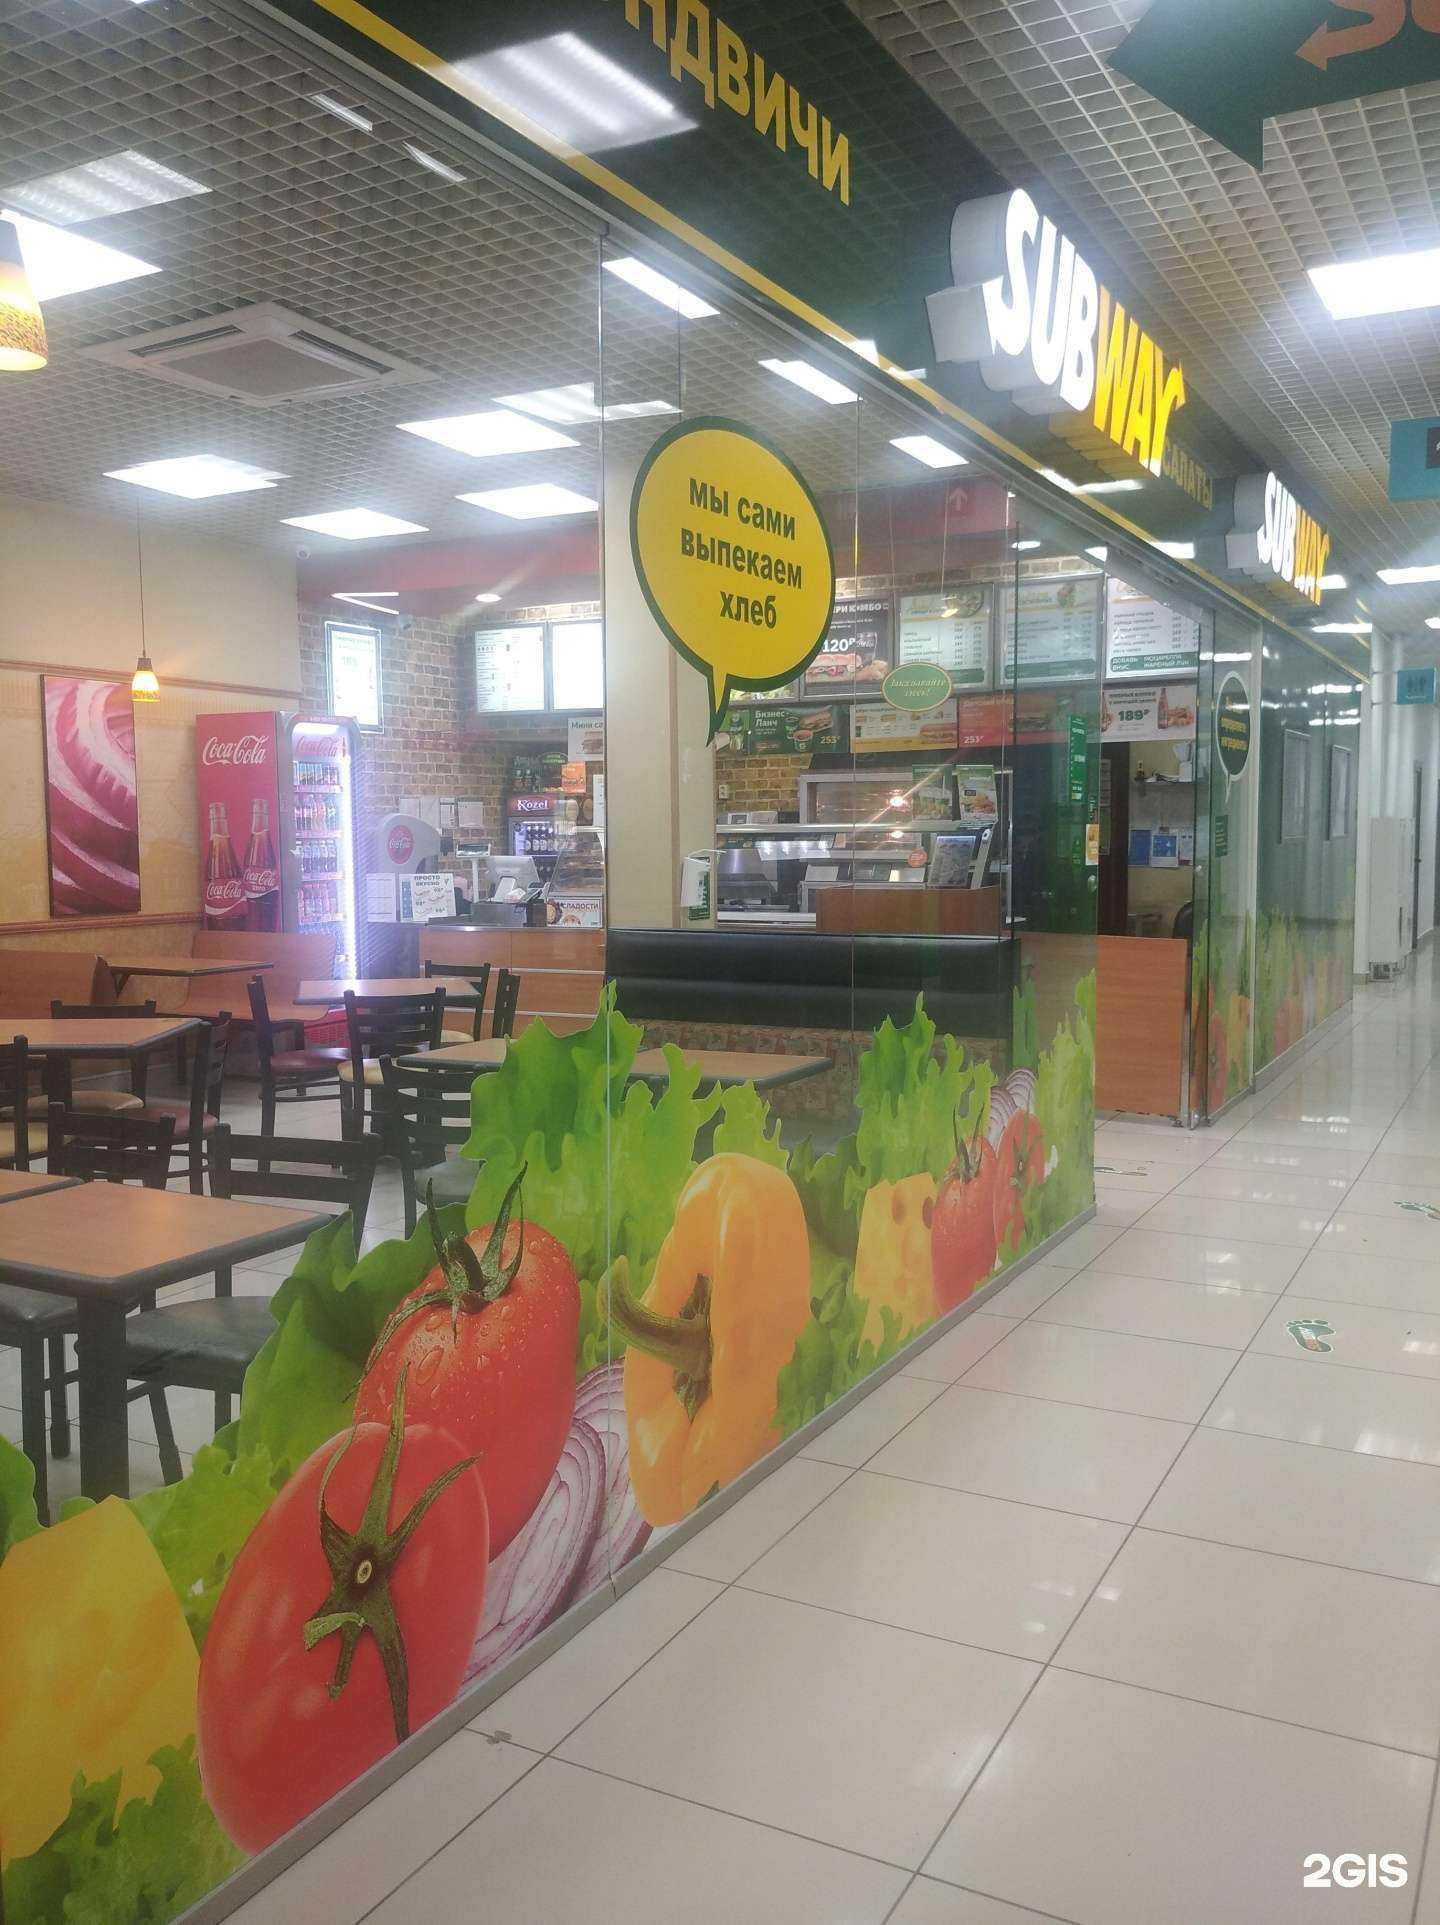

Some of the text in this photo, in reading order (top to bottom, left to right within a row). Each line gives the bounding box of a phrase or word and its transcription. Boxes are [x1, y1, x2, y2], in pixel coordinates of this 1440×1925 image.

[982, 188, 1186, 478] SUBWAY
[737, 496, 796, 540] сами
[681, 527, 802, 589] выпекаем
[1257, 471, 1330, 607] SUBWAY
[719, 590, 777, 629] хлеб
[203, 735, 269, 766] Coca-Cola
[517, 799, 549, 812] Kozel
[207, 880, 242, 900] Coca-Cola
